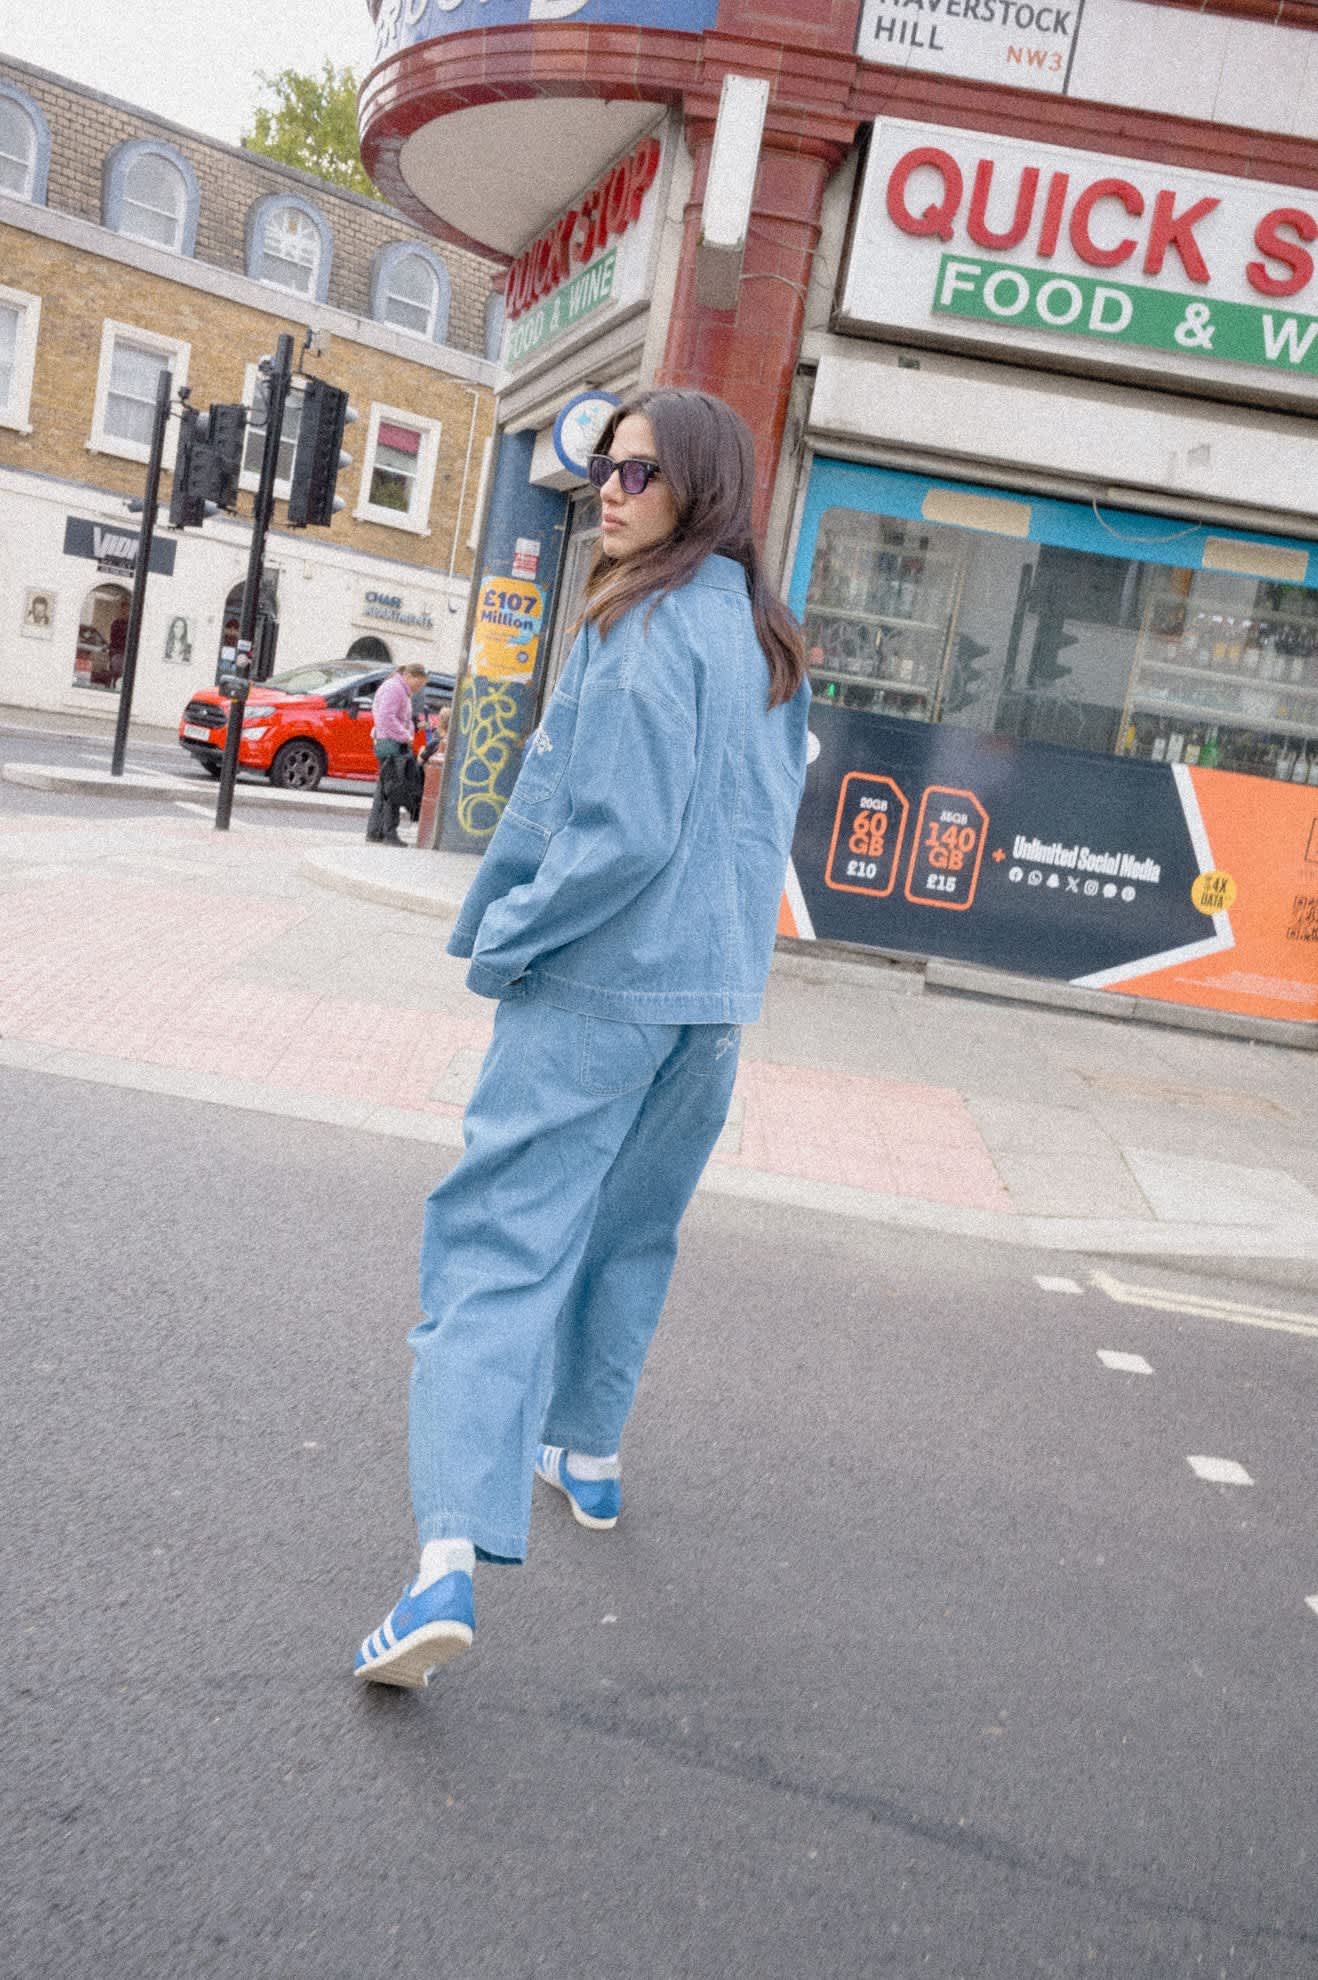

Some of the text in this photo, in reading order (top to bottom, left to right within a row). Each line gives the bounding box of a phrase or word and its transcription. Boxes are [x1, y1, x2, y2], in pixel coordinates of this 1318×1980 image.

[874, 15, 944, 50] HILL
[1006, 45, 1063, 73] NW3
[885, 146, 1222, 284] QUICK
[567, 254, 616, 318] WINE
[940, 261, 1134, 334] FOOD
[1174, 302, 1216, 350] &
[483, 588, 538, 614] £107
[480, 610, 534, 632] Million
[853, 810, 889, 837] 60
[925, 821, 977, 853] 140
[848, 832, 885, 857] GB
[846, 860, 878, 880] £10
[928, 846, 965, 872] GB
[1012, 834, 1079, 869] Unlimited
[1076, 846, 1121, 877] Social
[1118, 853, 1162, 884] Media
[926, 873, 957, 893] £15
[1200, 893, 1225, 908] DATA
